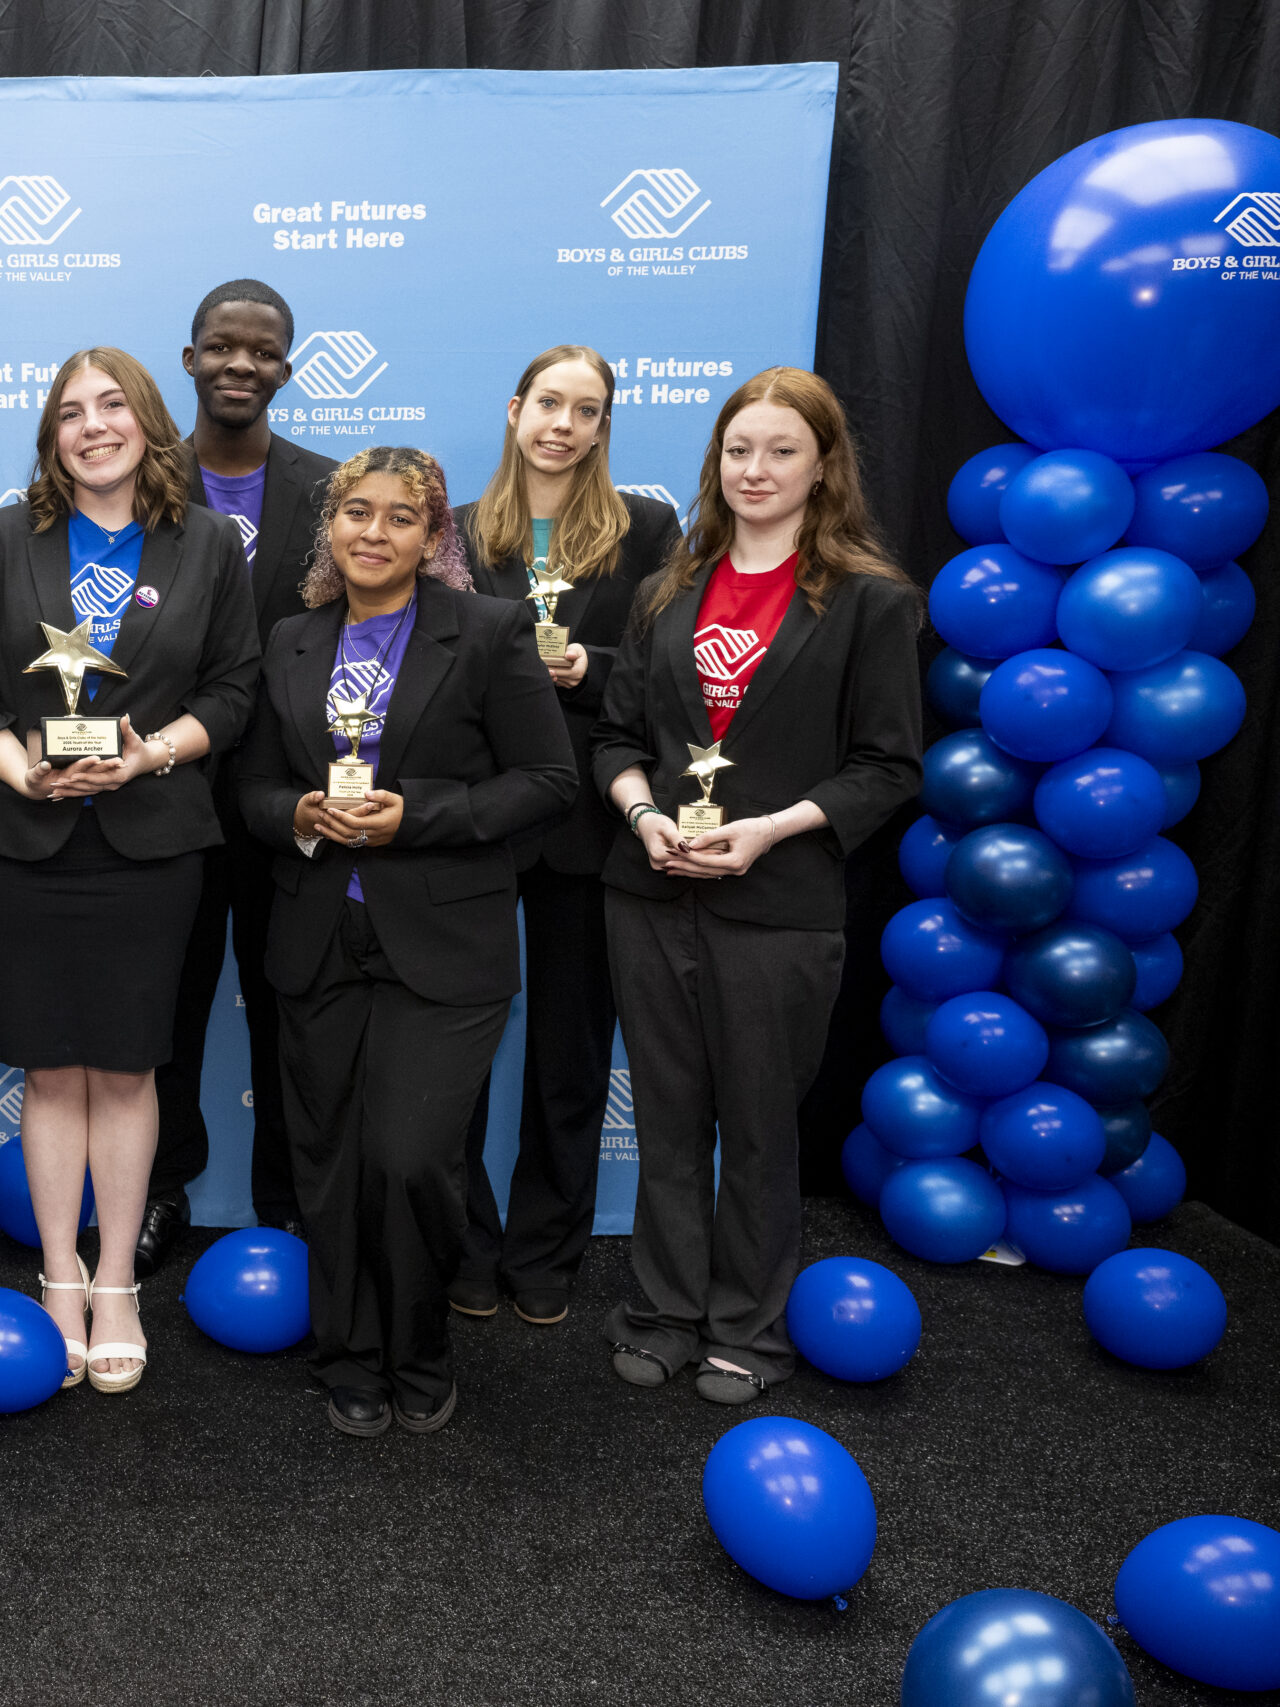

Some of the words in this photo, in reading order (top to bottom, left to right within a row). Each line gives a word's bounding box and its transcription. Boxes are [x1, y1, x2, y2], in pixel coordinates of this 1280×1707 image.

[252, 202, 322, 224] Great
[330, 200, 426, 222] Futures
[273, 229, 338, 250] Start
[346, 228, 404, 248] Here
[7, 254, 59, 268] GIRLS
[64, 253, 121, 268] CLUBS
[557, 248, 606, 263] BOYS
[610, 248, 625, 262] &
[629, 247, 684, 262] GIRLS
[688, 246, 748, 260] CLUBS
[608, 266, 623, 276] OF
[627, 266, 648, 275] THE
[652, 265, 696, 275] VALLEY
[1172, 256, 1221, 271] BOYS
[1224, 256, 1239, 268] &
[1242, 256, 1280, 268] GIRL
[5, 272, 27, 282] THE
[30, 272, 72, 282] VALLEY
[1221, 271, 1237, 280] OF
[1239, 270, 1259, 280] THE
[1262, 271, 1280, 280] VAL
[636, 358, 733, 377] Futures
[612, 385, 643, 405] art
[651, 384, 710, 404] Here
[267, 408, 289, 422] YS
[293, 408, 308, 422] &
[311, 407, 363, 421] GIRLS
[368, 407, 426, 421] CLUBS
[291, 426, 306, 435] OF
[309, 426, 331, 435] THE
[334, 425, 376, 435] VALLEY
[90, 619, 121, 634] IRLS
[98, 633, 117, 642] VAL
[703, 682, 740, 697] GIRLS
[715, 700, 741, 708] VALLE
[600, 1152, 612, 1160] HE
[615, 1152, 640, 1160] VALL
